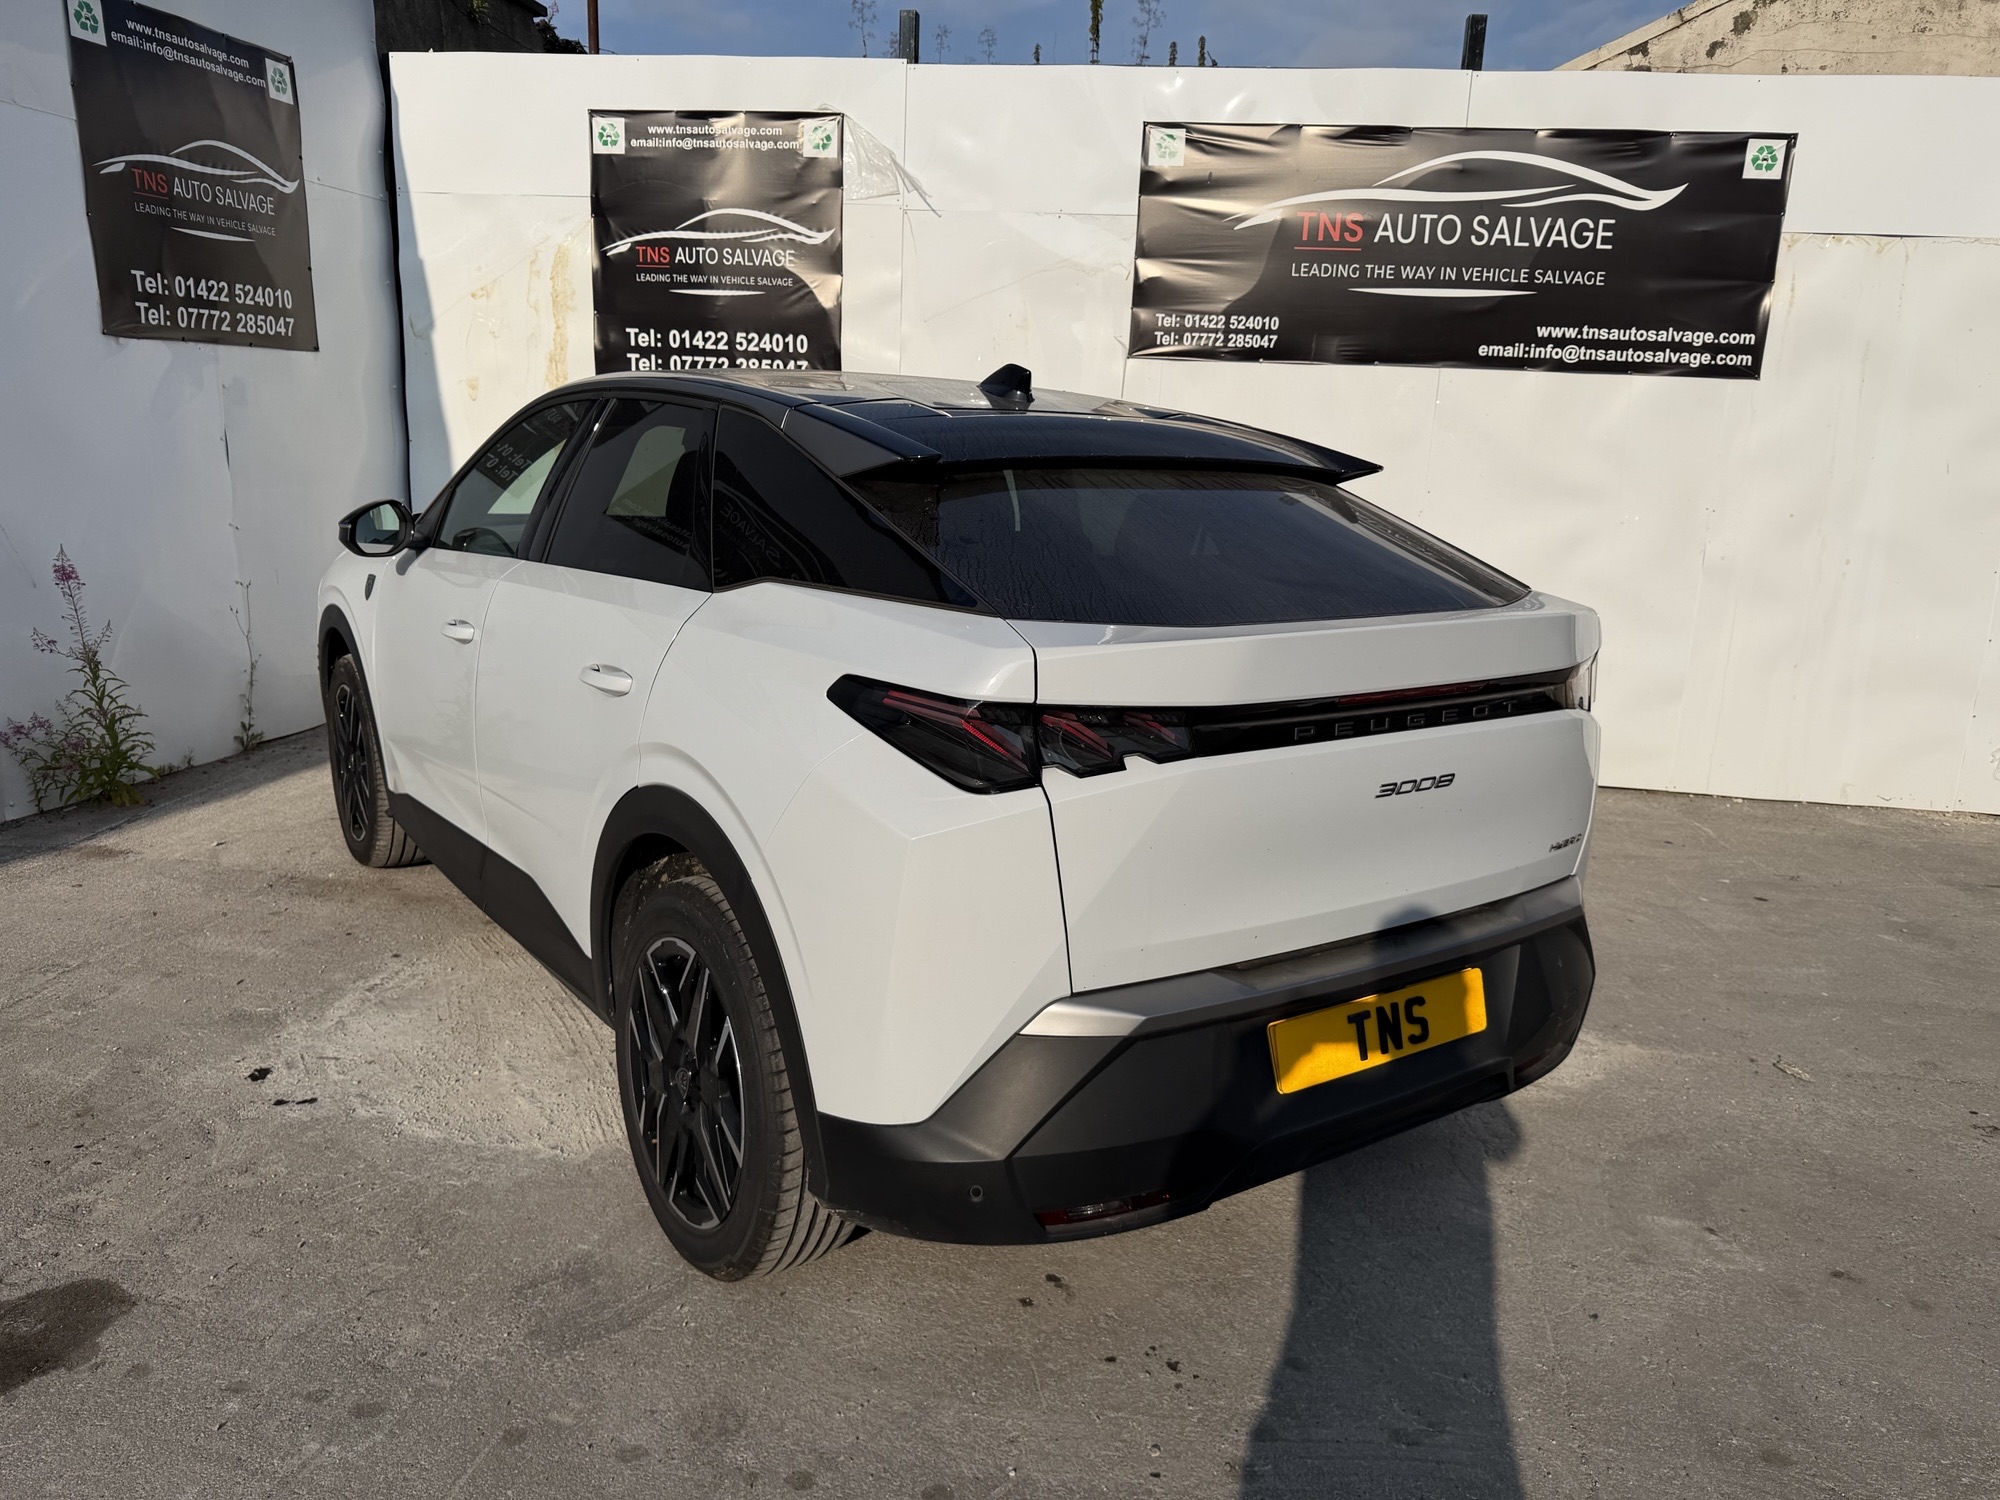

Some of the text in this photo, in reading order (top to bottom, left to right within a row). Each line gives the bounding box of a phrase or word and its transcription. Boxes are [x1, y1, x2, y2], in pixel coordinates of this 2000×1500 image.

[126, 19, 249, 68] www.tnsautosalvage.com
[111, 31, 266, 88] email:info@tnsautosalvage.com
[647, 125, 783, 137] www.tnsautosalvage.com
[630, 138, 800, 150] email:info@tnsautosalvage.com
[131, 168, 275, 215] TNS AUTO SALVAGE
[134, 202, 276, 237] LEADING THE WAY IN VEHICLE SALVAGE
[1296, 211, 1616, 250] TNS AUTO SALVAGE
[636, 246, 795, 267] TNS AUTO SALVAGE
[636, 273, 793, 287] LEADING THE WAY IN VEHICLE SALVAGE
[1291, 263, 1606, 286] LEADING THE WAY IN VEHICLE SALVAGE
[131, 269, 293, 310] Tel: 01422 524010
[135, 301, 295, 337] Tel: 07772 285047
[1156, 313, 1279, 330] Tel: 01422 524010
[626, 328, 808, 353] Tel: 01422 524010
[1154, 331, 1278, 348] Tel: 07772 285047
[1536, 324, 1756, 346] www.tnsautosalvage.com
[626, 353, 662, 371] Tel:
[1478, 343, 1752, 367] email:info@tnsautosalvage.com
[1294, 700, 1519, 741] PEUGEOT
[1374, 772, 1456, 799] 3008
[1347, 995, 1430, 1062] TNS
